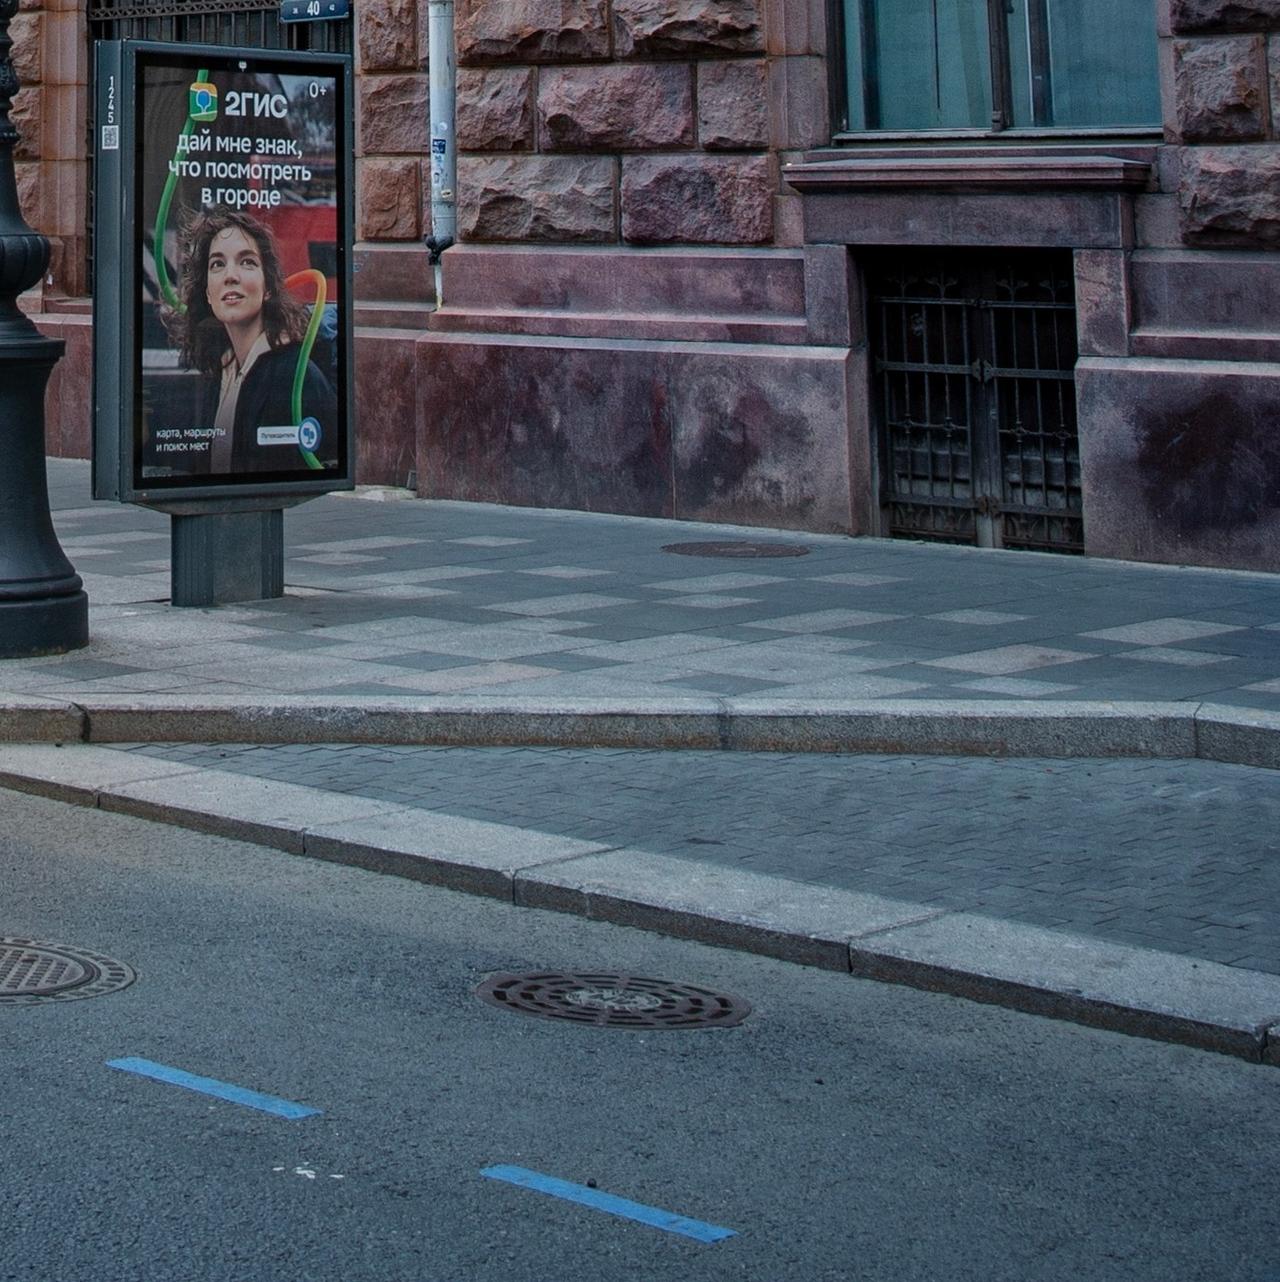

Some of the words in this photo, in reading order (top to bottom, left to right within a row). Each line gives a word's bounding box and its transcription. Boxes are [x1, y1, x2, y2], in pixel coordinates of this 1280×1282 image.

[307, 0, 320, 16] 40
[309, 82, 327, 98] 0+
[224, 91, 288, 119] 2ГИС
[177, 128, 211, 154] дай
[216, 136, 251, 153] мне
[255, 137, 303, 159] знак,
[169, 160, 201, 177] что
[205, 162, 312, 185] посмотреть
[201, 188, 212, 204] в
[216, 188, 281, 209] городе
[156, 429, 182, 440] карта,
[183, 428, 226, 439] маршруты
[156, 443, 162, 452] и
[163, 443, 188, 452] поиск
[189, 442, 210, 451] мест
